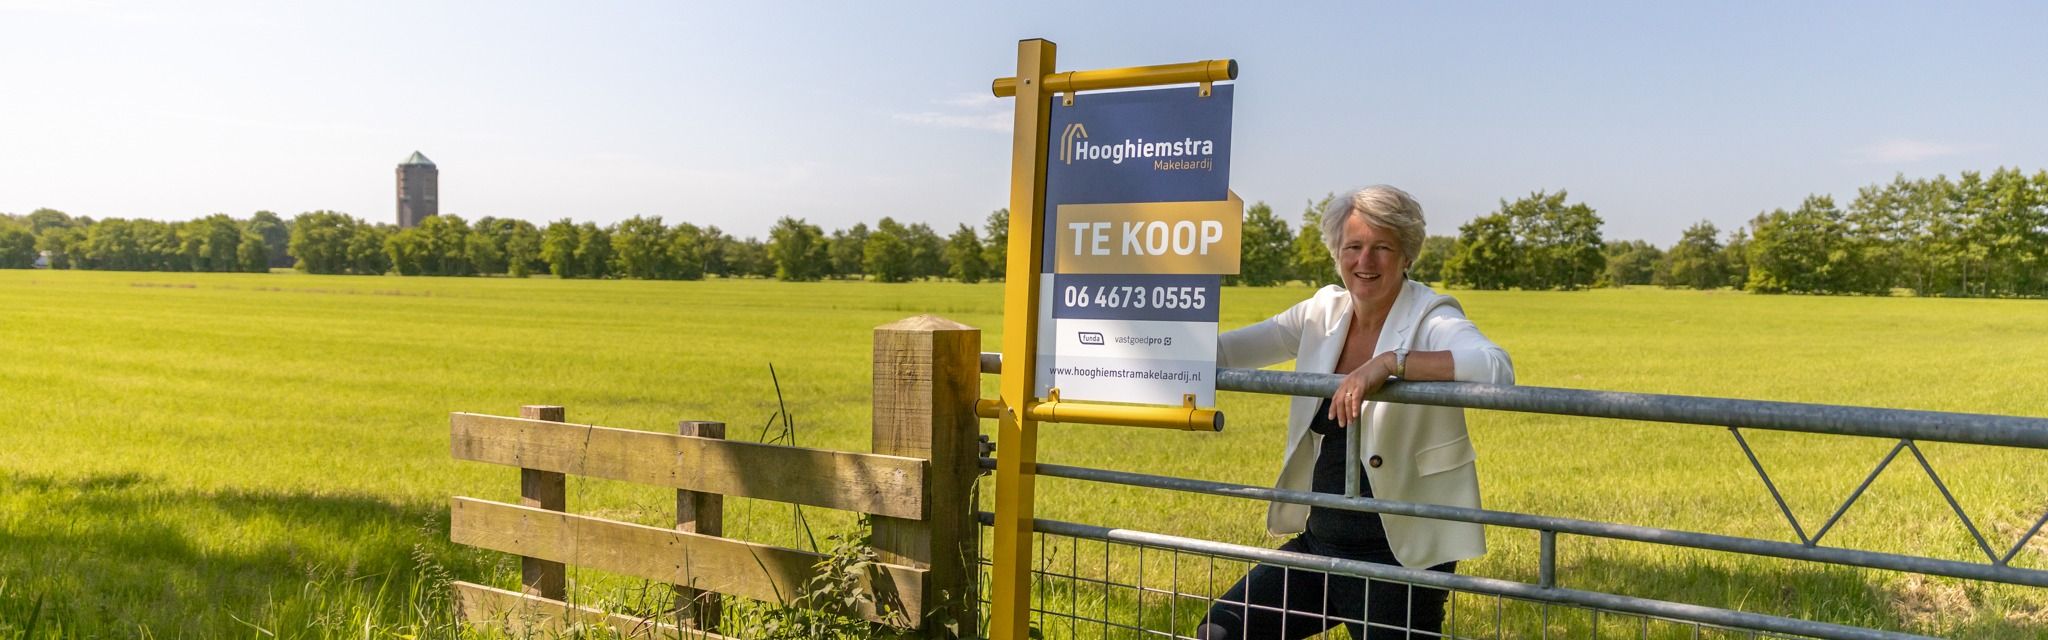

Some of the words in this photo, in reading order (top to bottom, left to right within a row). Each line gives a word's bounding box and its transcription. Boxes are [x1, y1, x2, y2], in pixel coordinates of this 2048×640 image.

[1075, 137, 1213, 164] Hooghiemstra
[1154, 158, 1212, 171] Makelaardij
[1069, 222, 1112, 256] TE
[1121, 220, 1223, 256] KOOP
[1064, 285, 1089, 307] 06
[1094, 286, 1146, 309] 4673
[1152, 286, 1206, 310] 0555
[1082, 334, 1101, 342] funda
[1115, 336, 1162, 346] vastgoedpro
[1049, 366, 1201, 383] www.hooghiemstramakelaardij.nl
